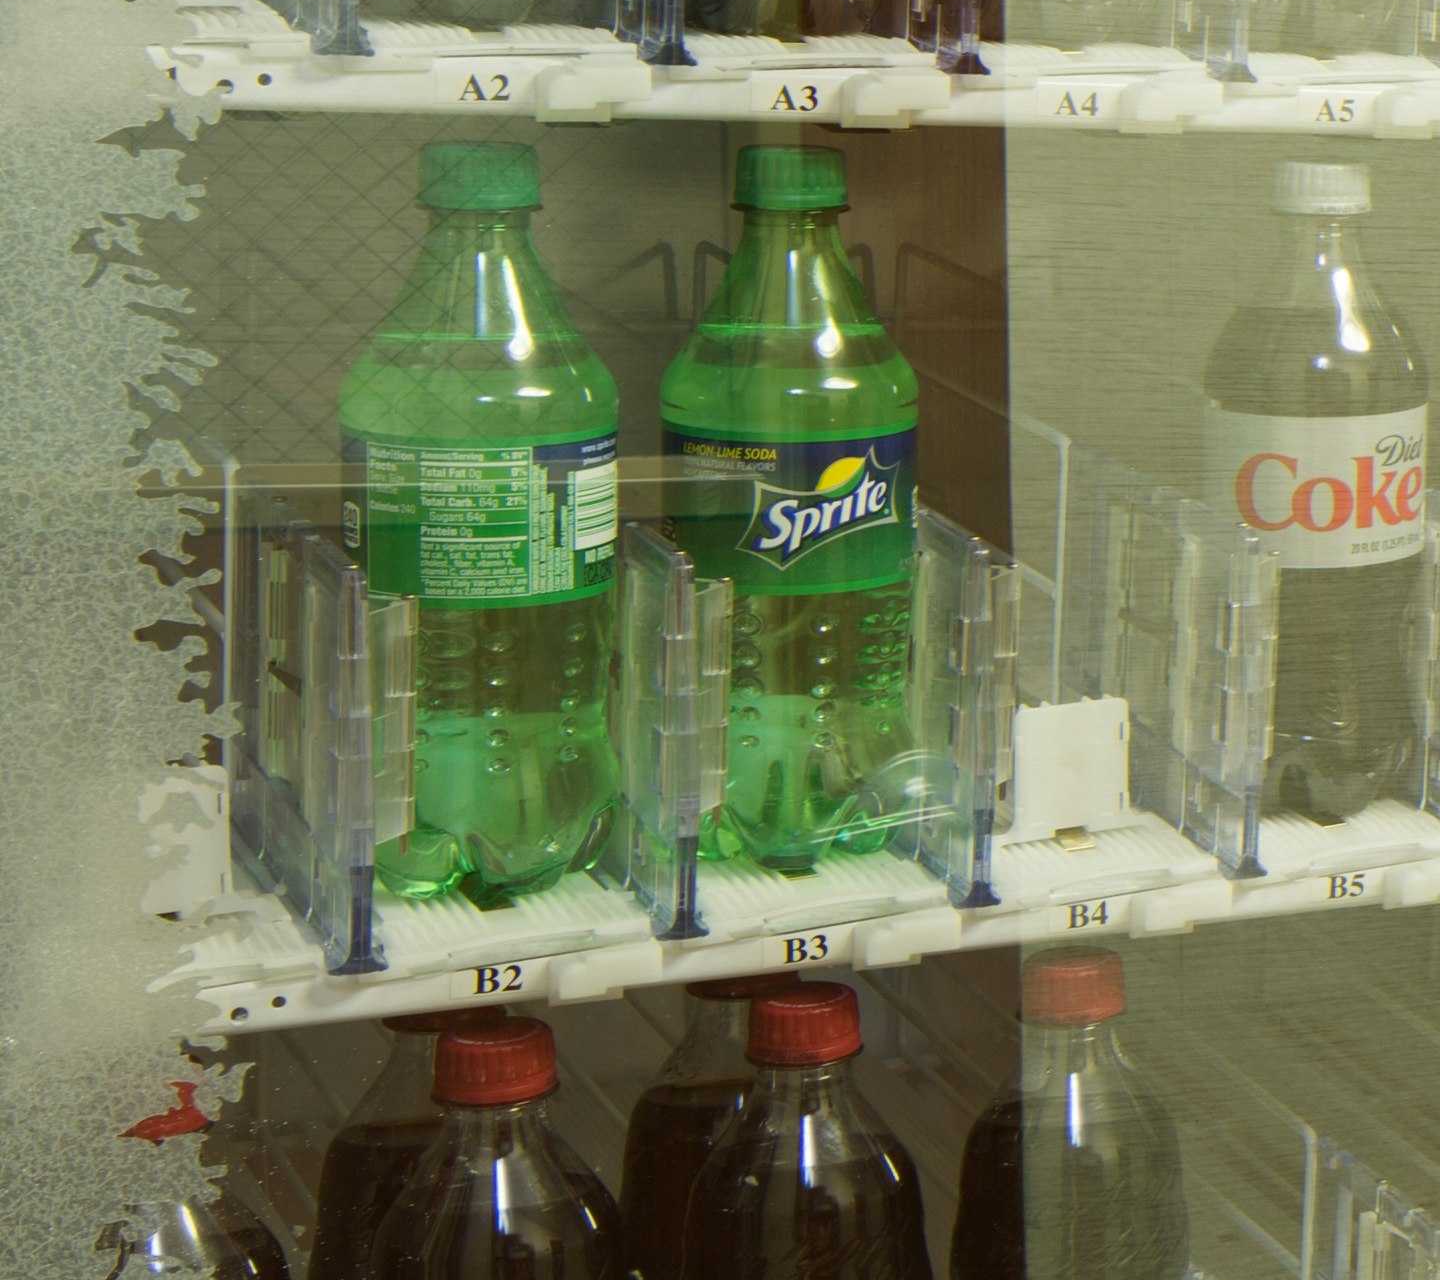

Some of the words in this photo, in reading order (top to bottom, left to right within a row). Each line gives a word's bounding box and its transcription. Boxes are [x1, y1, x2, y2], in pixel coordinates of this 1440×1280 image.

[458, 73, 510, 102] A2
[769, 84, 819, 112] A3
[1055, 91, 1099, 118] A4
[1314, 98, 1355, 123] A5
[370, 447, 415, 461] Nutrition
[683, 441, 742, 459] LEMON-LIME
[744, 448, 777, 460] SODA
[1376, 434, 1424, 466] Diet
[370, 460, 397, 471] Facts
[420, 467, 446, 477] Total
[449, 468, 466, 477] Fat
[469, 468, 482, 480] 0g
[420, 482, 457, 492] Sodium
[461, 483, 495, 493] 110mg
[1235, 453, 1422, 533] Coke
[401, 504, 416, 514] 240
[421, 497, 445, 506] Total
[448, 497, 475, 507] Carb.
[479, 498, 499, 508] 64g
[759, 472, 887, 553] Sprite
[420, 525, 458, 536] Protein
[429, 512, 464, 523] Sugars
[467, 512, 486, 523] 64g
[1326, 873, 1366, 900] B5
[1066, 900, 1109, 930] B4
[782, 933, 829, 965] B3
[471, 964, 523, 996] B2
